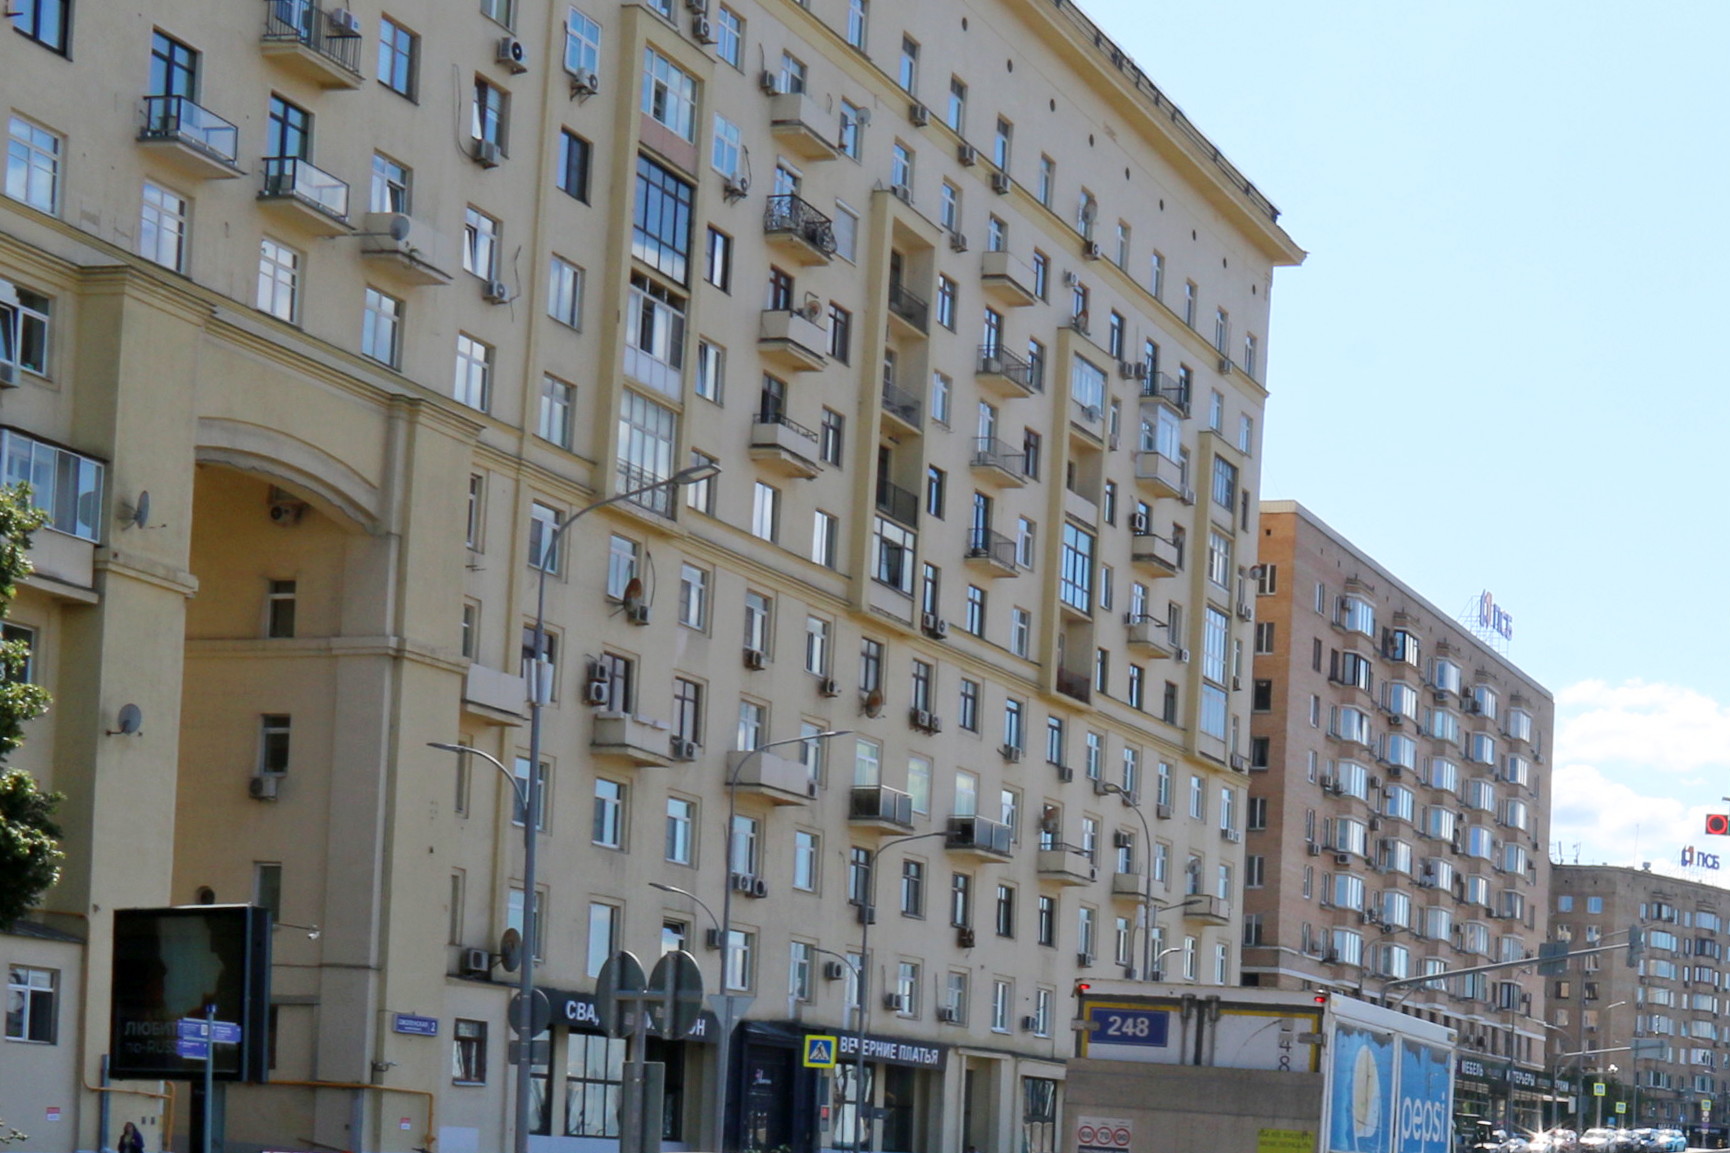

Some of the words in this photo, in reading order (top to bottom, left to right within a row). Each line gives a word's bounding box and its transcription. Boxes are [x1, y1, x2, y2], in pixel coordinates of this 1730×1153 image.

[1697, 850, 1720, 870] ПСБ
[124, 1021, 177, 1036] ЛЮБИТ
[430, 1021, 437, 1032] 2
[1106, 1015, 1150, 1037] 248
[899, 1045, 939, 1064] ПЛАТЬЯ
